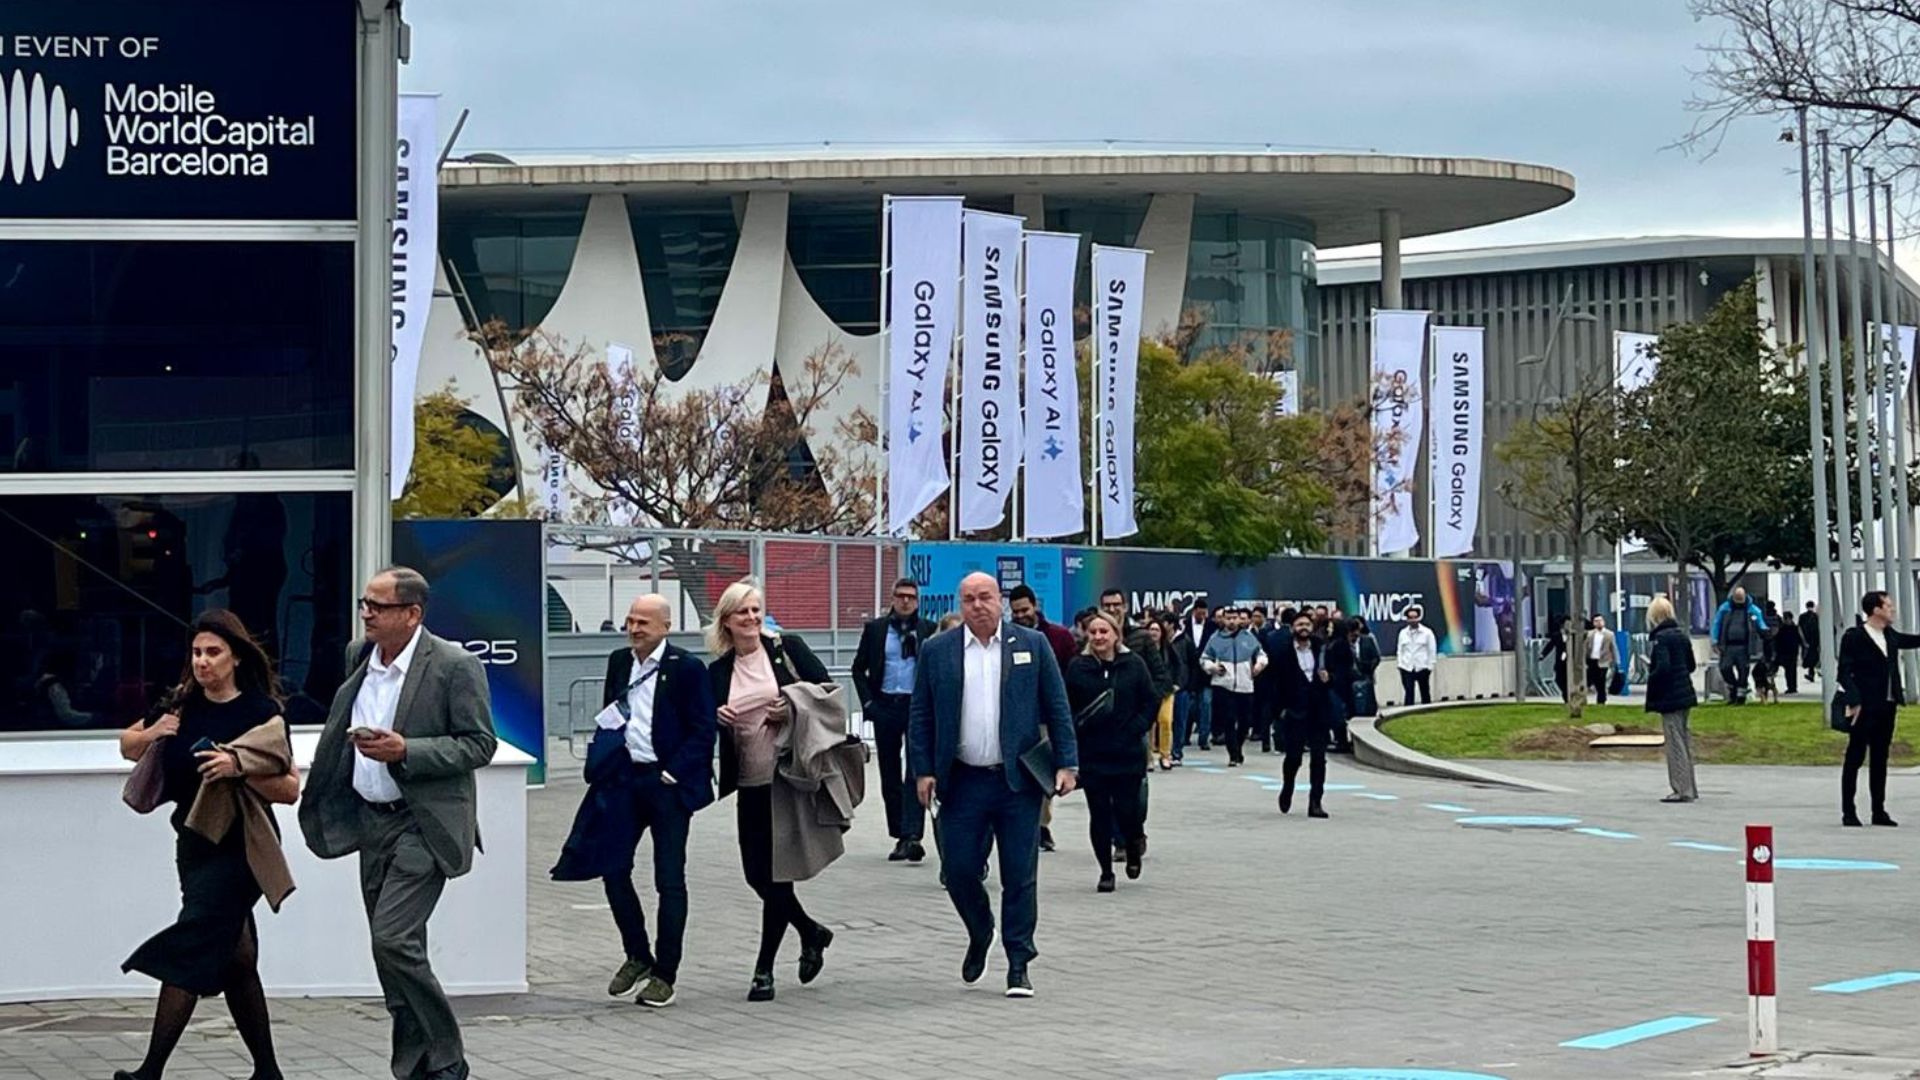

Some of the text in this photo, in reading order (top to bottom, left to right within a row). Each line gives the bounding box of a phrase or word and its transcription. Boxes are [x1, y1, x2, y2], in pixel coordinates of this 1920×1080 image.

[15, 36, 109, 57] EVENT
[119, 37, 159, 57] OF
[104, 84, 215, 113] Mobile
[104, 115, 315, 147] WorldCapital
[107, 146, 268, 175] Barcelona
[907, 280, 935, 381] Galaxy
[977, 245, 1003, 494] SAMSUNG Galaxy
[1041, 308, 1061, 430] Galaxy AI
[1105, 420, 1120, 505] Galaxy
[1447, 352, 1469, 531] SAMSUNG Galaxy
[1359, 593, 1424, 622] MWC25
